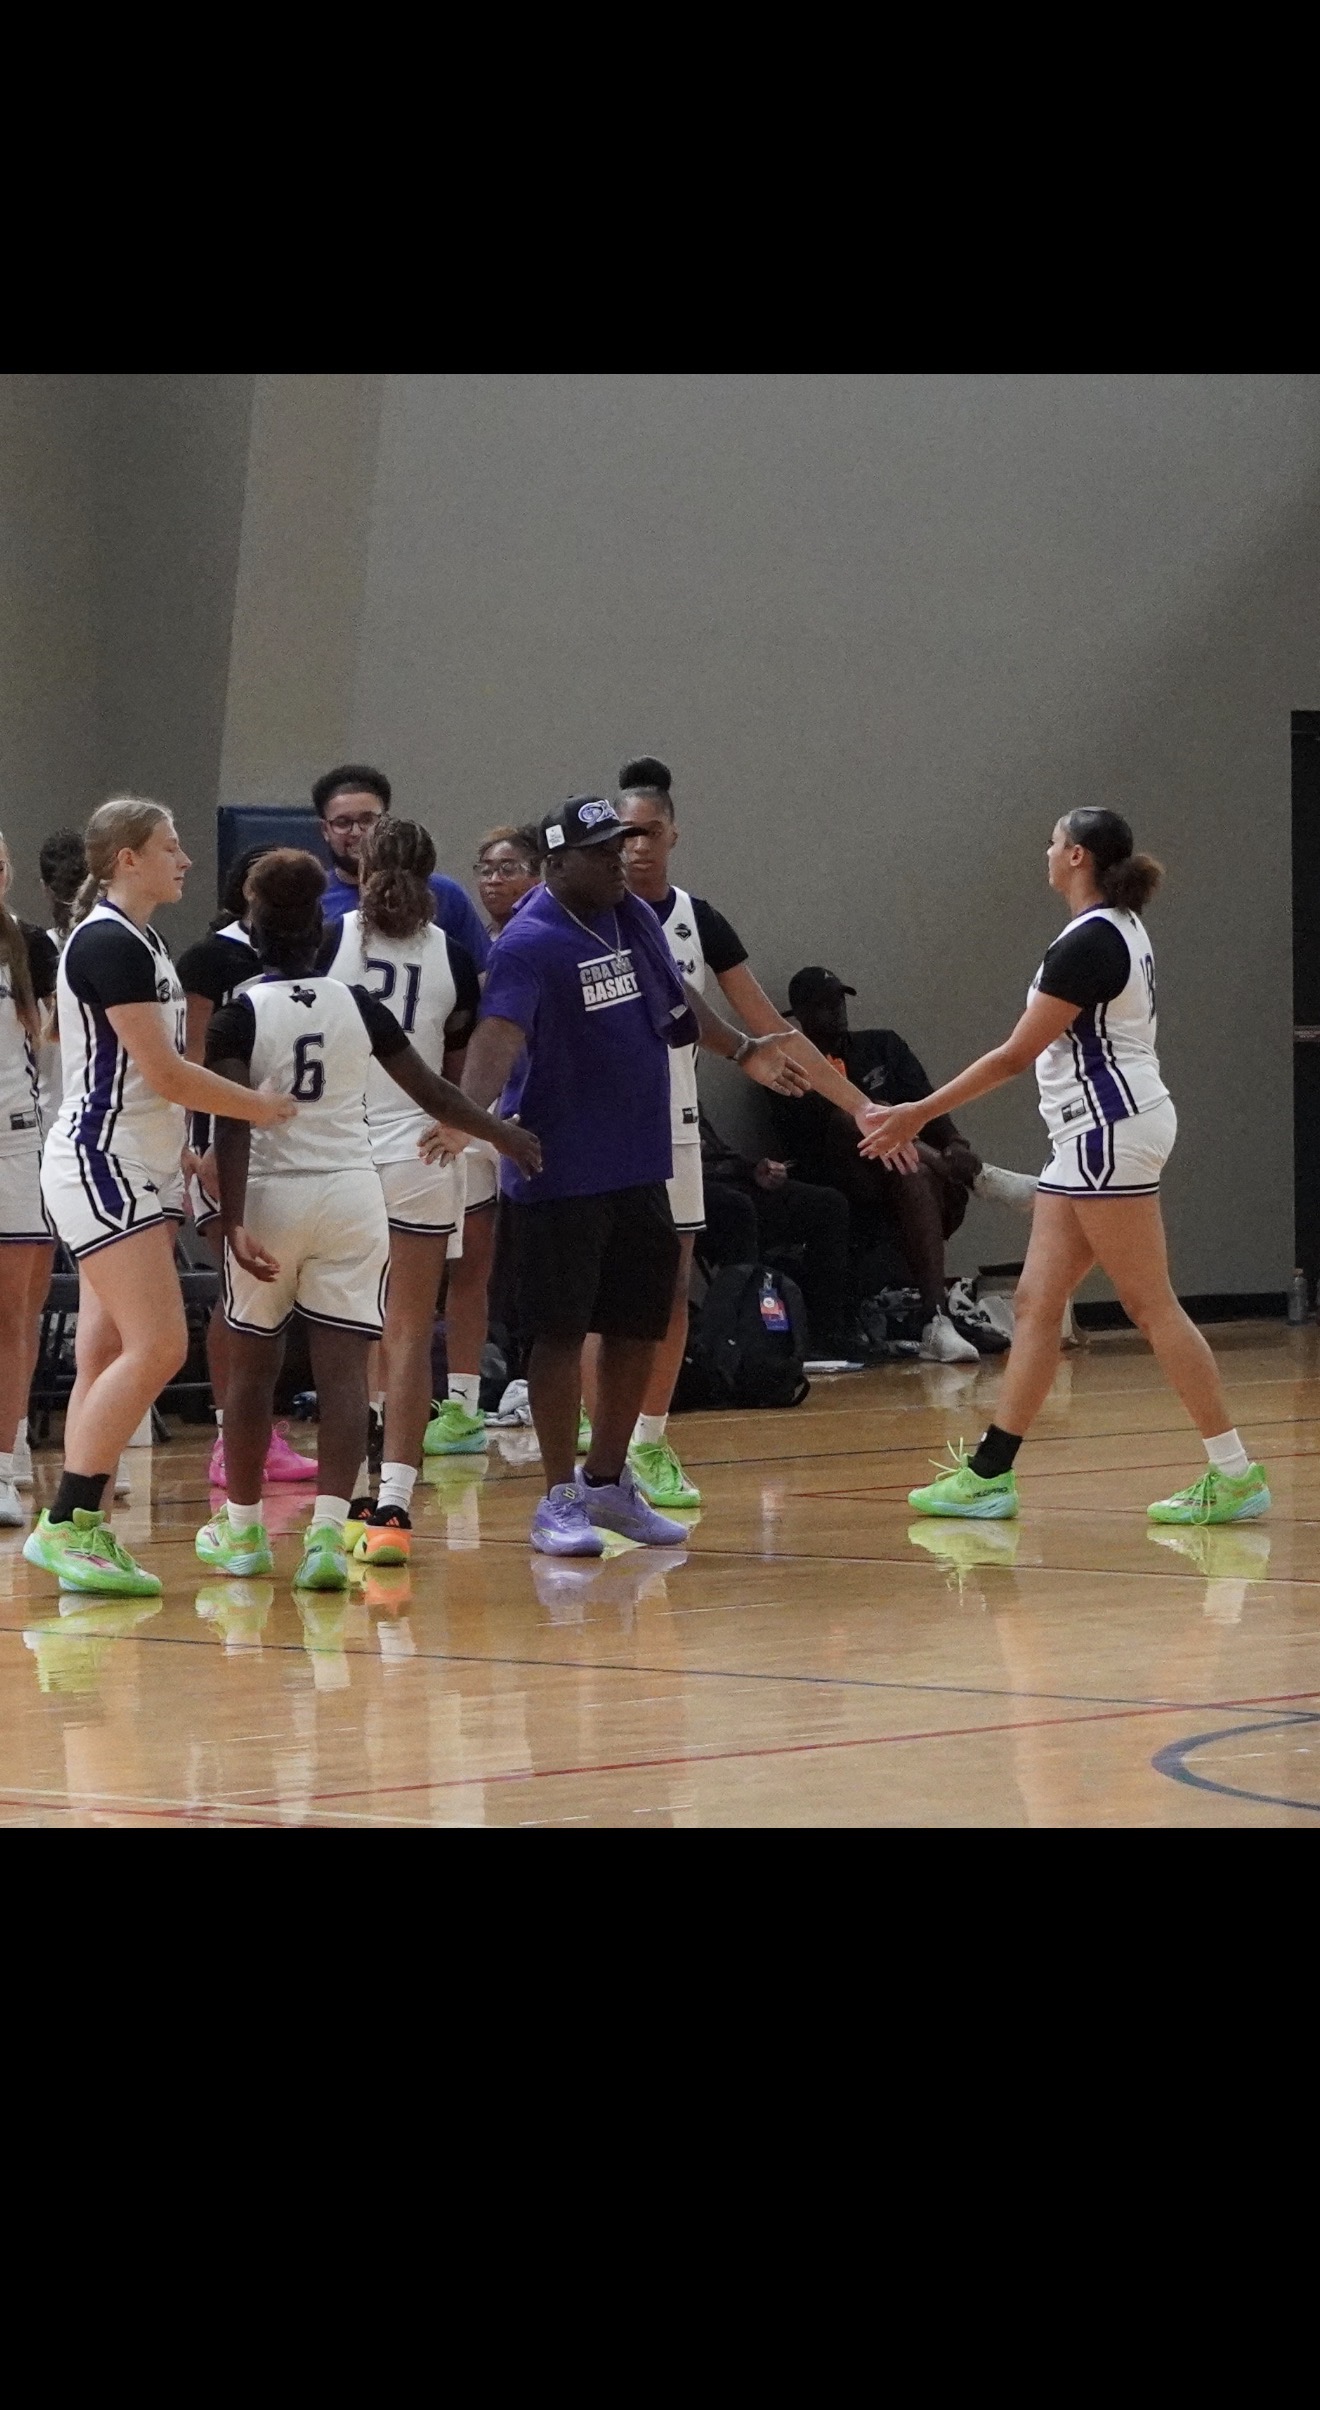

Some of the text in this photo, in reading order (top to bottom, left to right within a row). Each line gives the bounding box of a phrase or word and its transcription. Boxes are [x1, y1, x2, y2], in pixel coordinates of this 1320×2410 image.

[580, 963, 613, 985] CBA
[582, 972, 639, 1005] BASKET
[292, 1032, 326, 1103] 6
